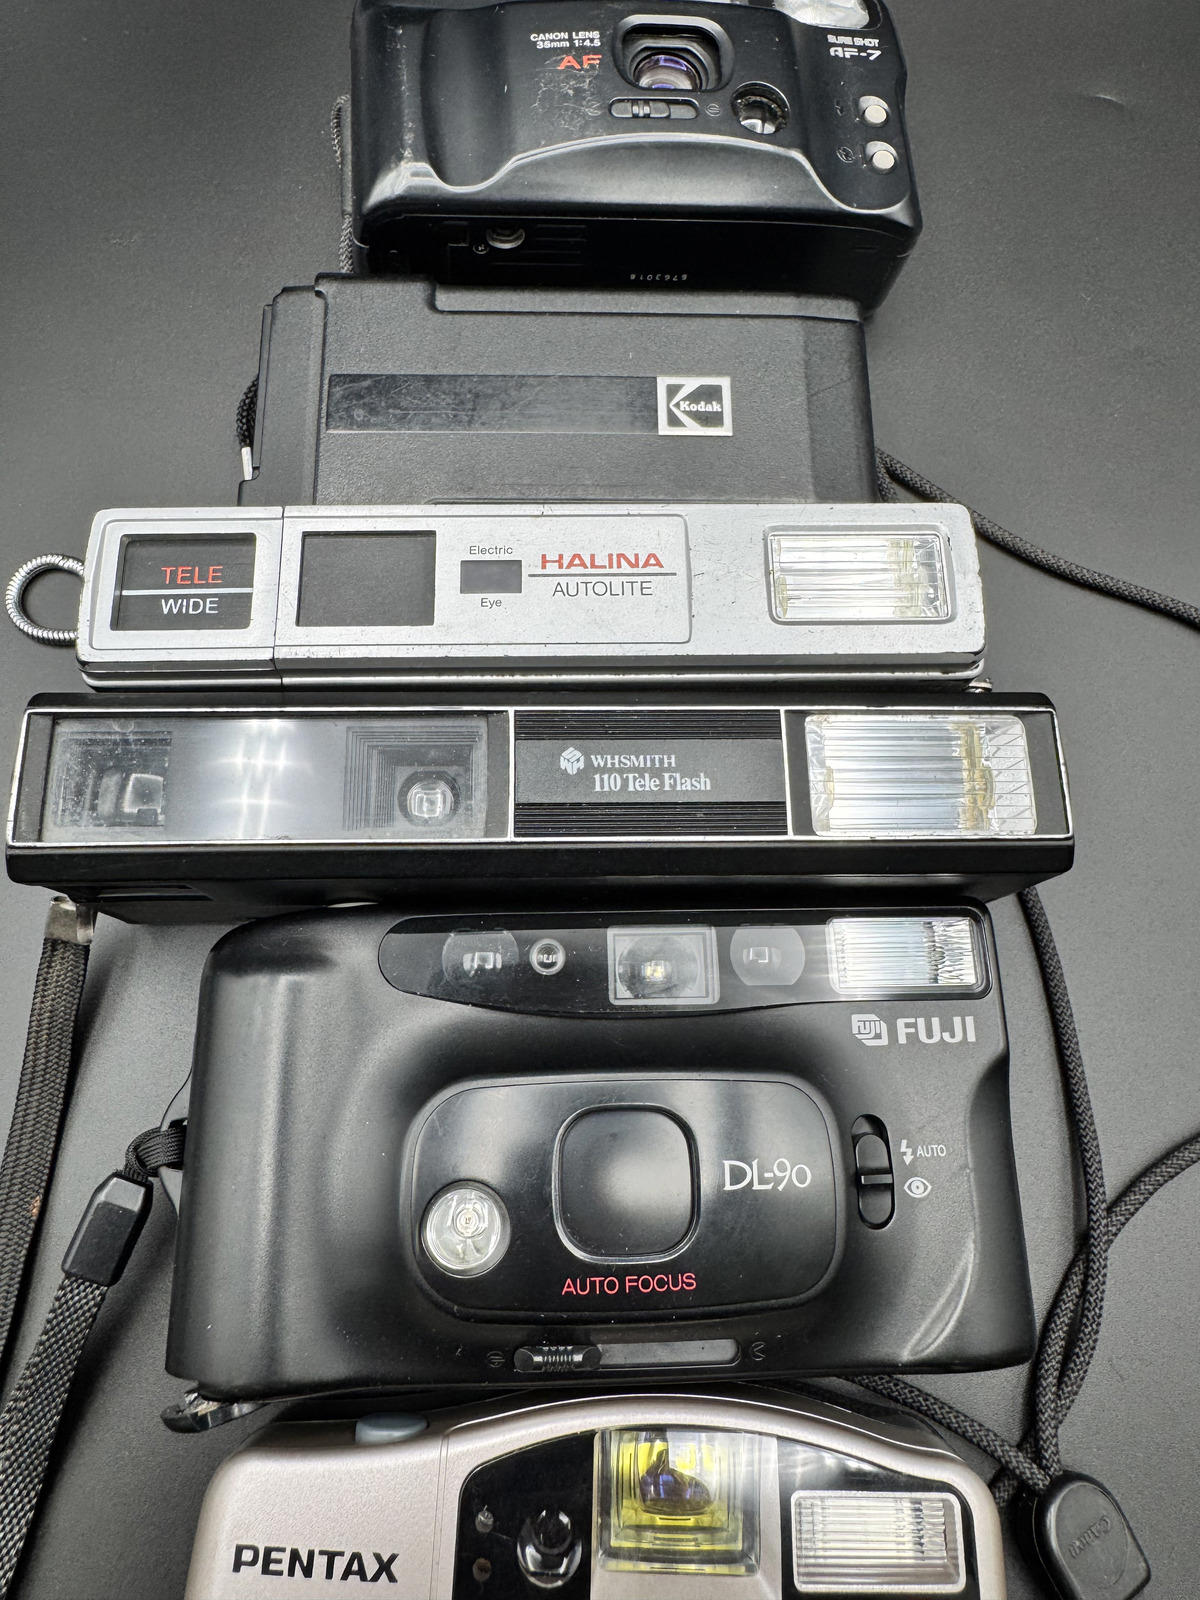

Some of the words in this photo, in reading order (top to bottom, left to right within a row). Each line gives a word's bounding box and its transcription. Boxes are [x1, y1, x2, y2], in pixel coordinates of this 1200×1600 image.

[530, 32, 568, 41] CANON
[572, 31, 600, 39] LENS
[536, 41, 569, 49] 35mm
[573, 39, 601, 47] 1:4.5
[853, 37, 879, 47] SHOT
[830, 47, 881, 60] AF-7
[557, 54, 602, 70] AF
[679, 401, 722, 412] Kodak
[469, 546, 513, 555] Electric
[541, 553, 664, 570] HALINA
[161, 566, 223, 584] TELE
[552, 581, 653, 597] AUTOLITE
[161, 598, 219, 614] WIDE
[480, 597, 502, 609] Eye
[590, 754, 676, 768] WHSMITH
[593, 773, 622, 791] 110
[623, 773, 661, 791] Tele
[662, 772, 712, 791] Flash
[896, 1015, 976, 1044] FUJI
[916, 1145, 947, 1157] AUTO
[722, 1158, 812, 1191] DL-90
[562, 1276, 619, 1296] AUTO
[625, 1272, 697, 1294] FOCUS
[232, 1543, 399, 1583] PENTAX
